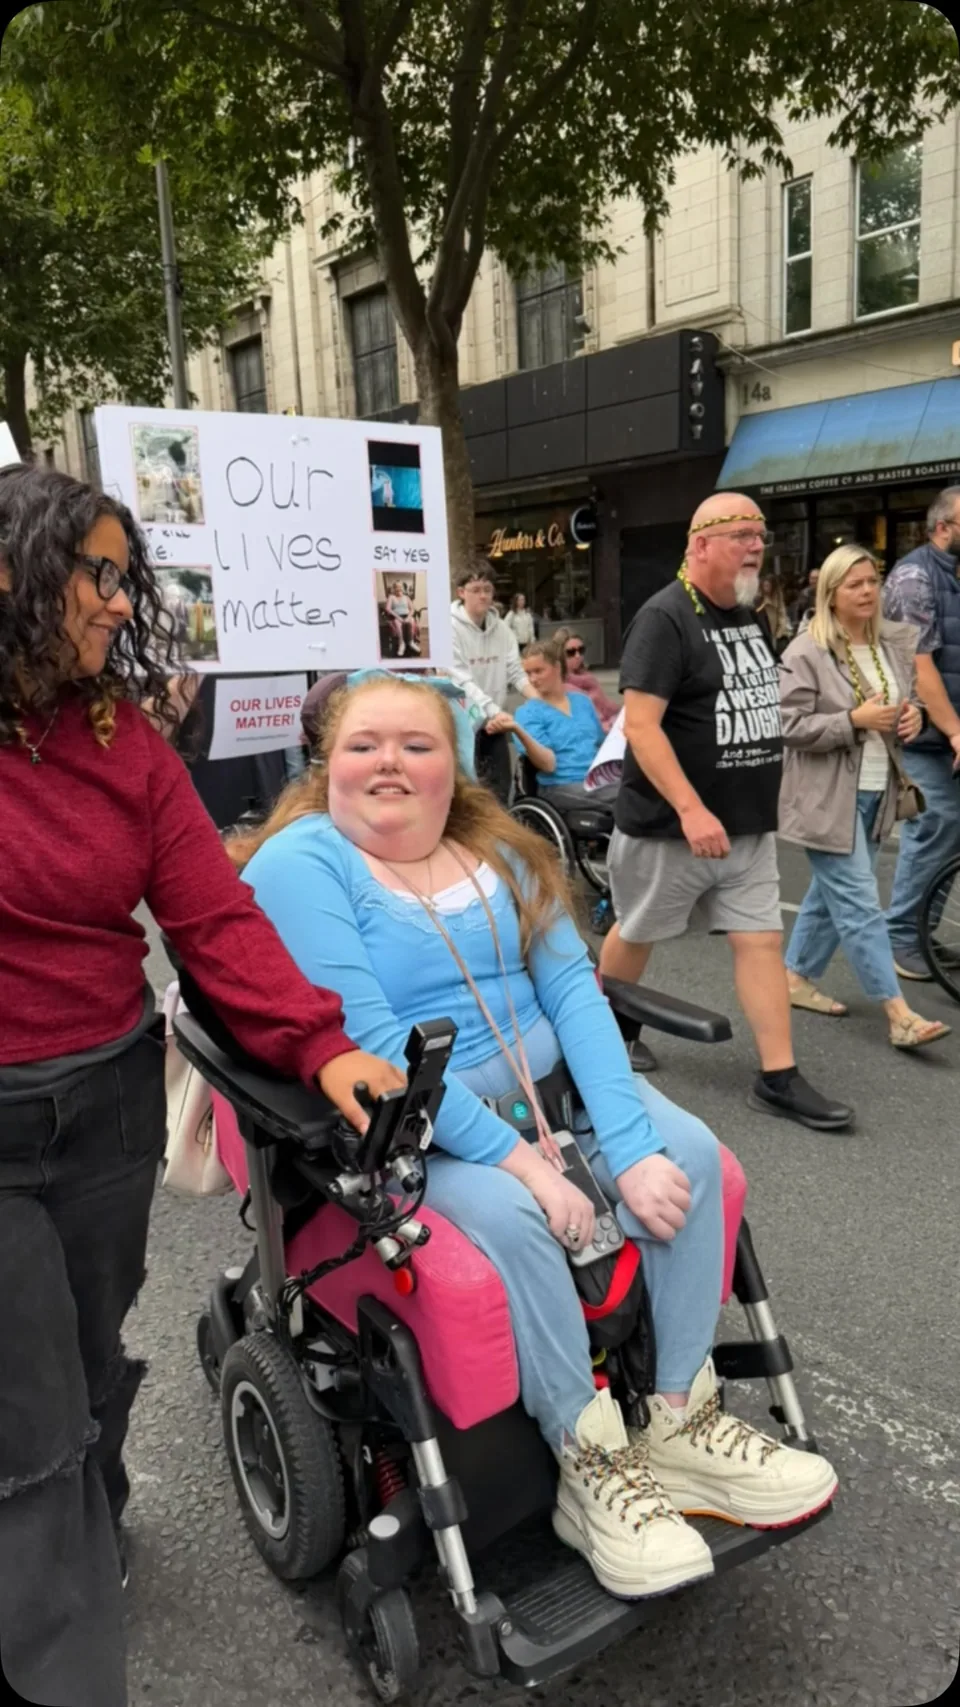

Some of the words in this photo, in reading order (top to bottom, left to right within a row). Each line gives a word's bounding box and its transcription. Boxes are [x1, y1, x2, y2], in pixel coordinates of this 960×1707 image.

[743, 382, 772, 408] 14a
[760, 485, 774, 495] THE
[775, 481, 807, 493] ITALIAN
[808, 477, 839, 489] COFFEE
[855, 473, 875, 483] AND
[877, 468, 912, 480] MASTER
[535, 529, 546, 549] &
[373, 545, 398, 563] SAY
[402, 548, 430, 563] YES
[715, 637, 775, 676] DAD
[230, 698, 261, 713] OUR
[265, 695, 302, 710] LIVES
[235, 713, 295, 730] MATTER!
[715, 705, 781, 745] DAUGH
